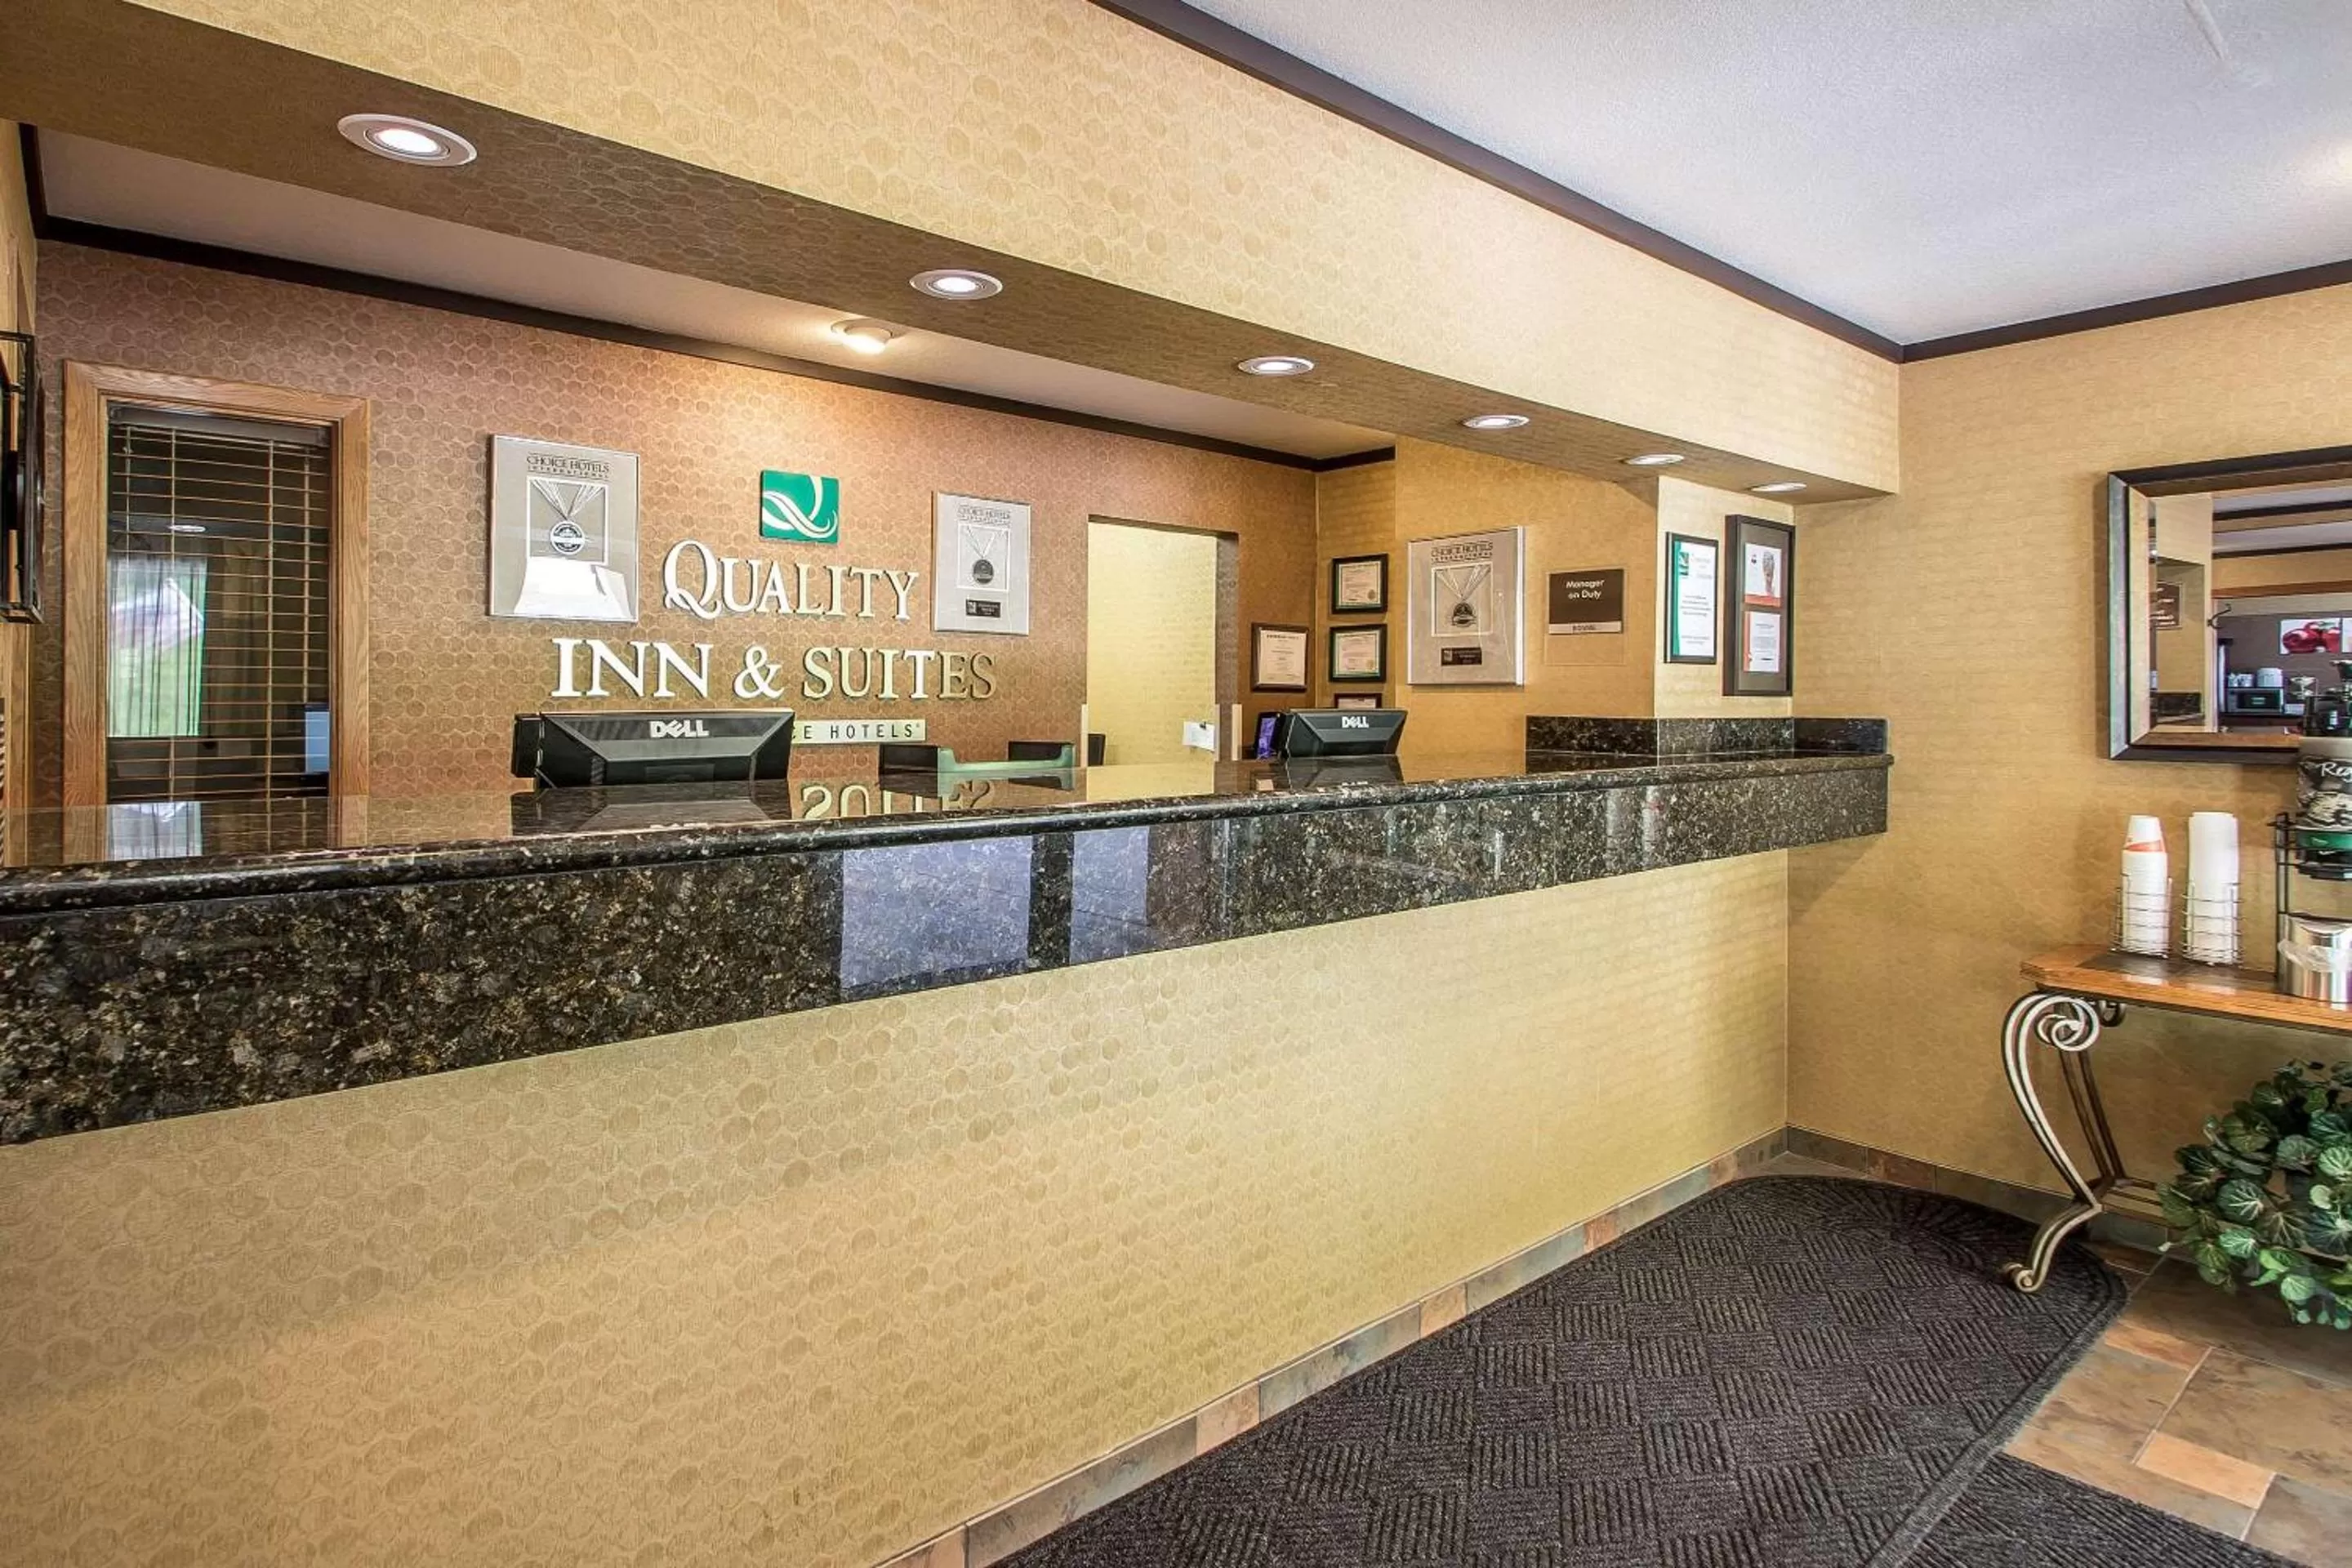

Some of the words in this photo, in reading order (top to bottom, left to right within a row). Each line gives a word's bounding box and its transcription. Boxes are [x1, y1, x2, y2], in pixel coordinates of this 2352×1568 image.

[527, 455, 567, 467] CHOICE
[569, 461, 610, 474] HOTELS
[664, 539, 920, 621] QUALITY
[1566, 580, 1605, 589] Manager
[1581, 589, 1601, 599] Duty
[550, 637, 714, 699] INN
[733, 644, 785, 700] &
[802, 647, 998, 701] SUITES
[649, 719, 710, 738] DELL
[1341, 715, 1370, 728] DELL
[830, 724, 913, 738] HOTELS
